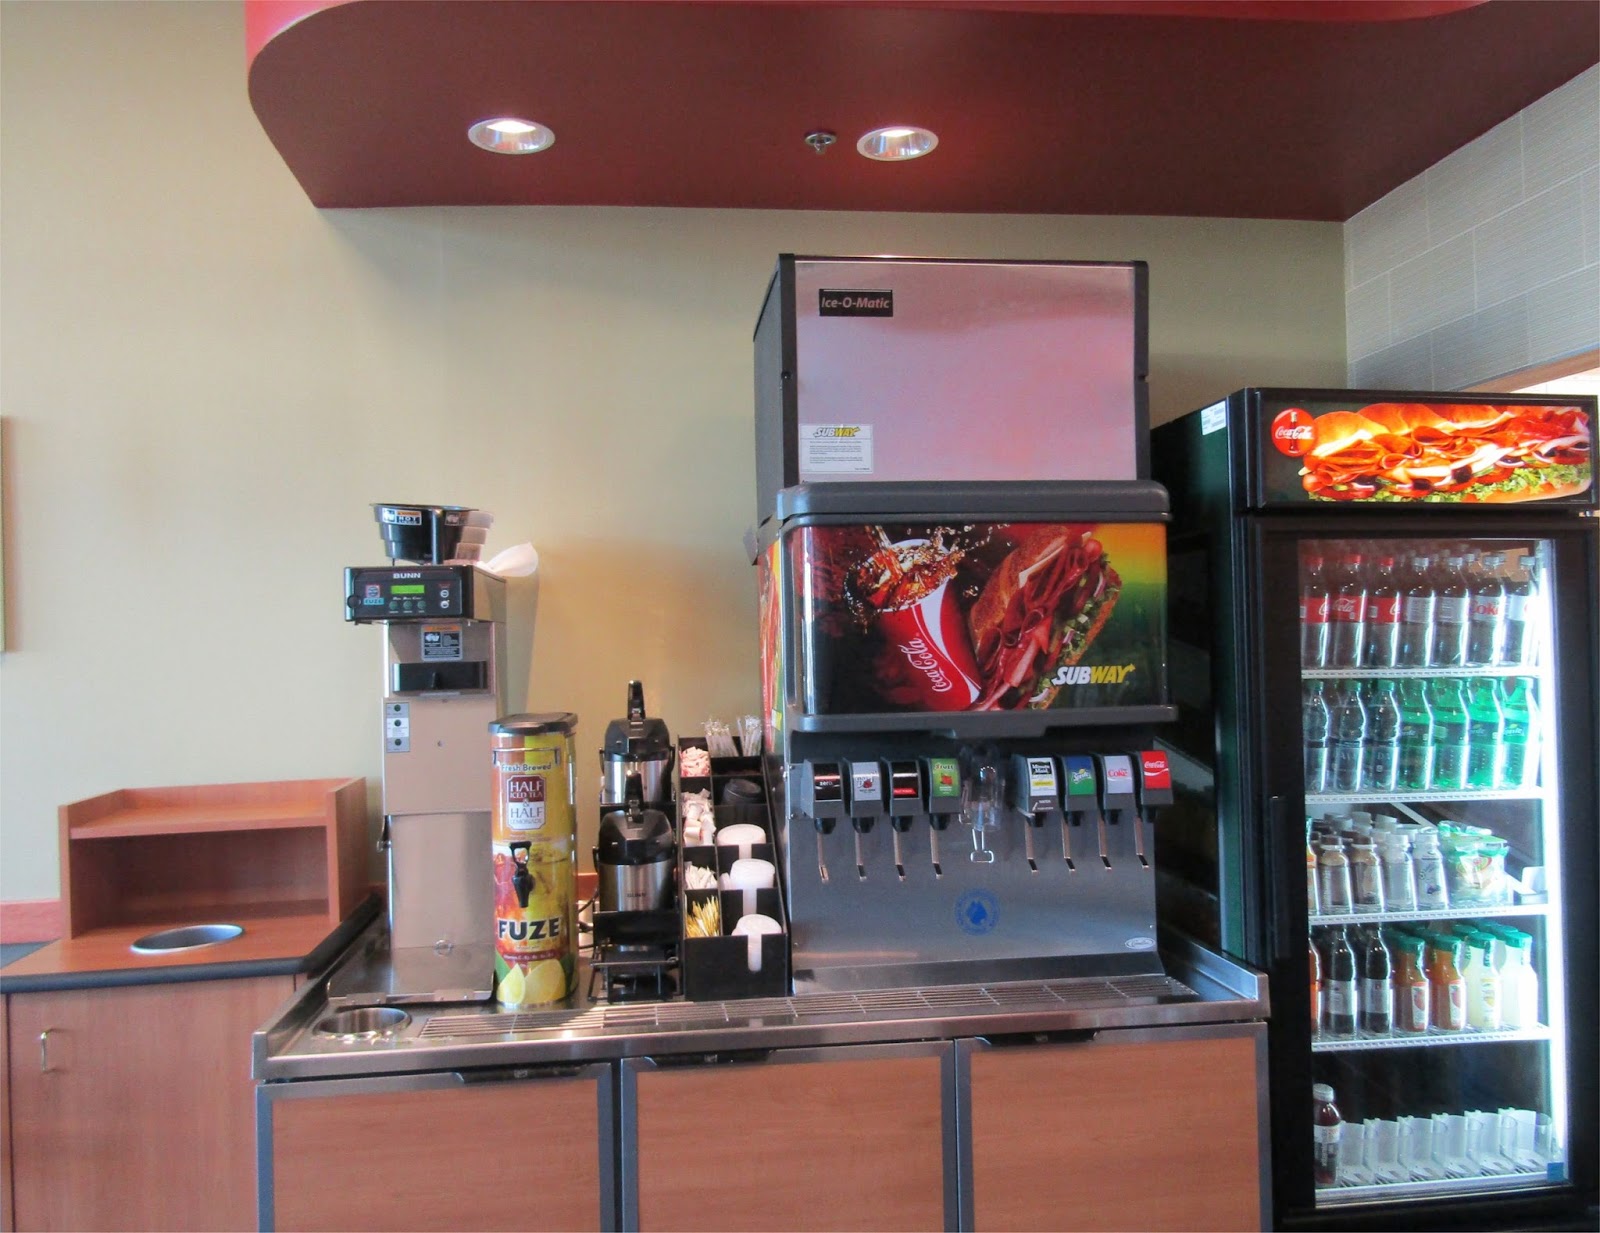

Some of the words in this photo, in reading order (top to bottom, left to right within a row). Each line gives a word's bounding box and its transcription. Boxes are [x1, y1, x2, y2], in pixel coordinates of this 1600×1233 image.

[821, 297, 890, 309] Ice-O-Matic
[813, 426, 861, 438] SUBWAY
[1275, 425, 1314, 440] Coca-Cola
[898, 637, 953, 692] Coca-Cola
[1051, 663, 1136, 686] SUBWAY
[502, 764, 520, 772] Fresh
[523, 763, 552, 771] Brewed
[1107, 769, 1128, 778] Coke
[510, 781, 543, 792] HALF
[510, 807, 543, 819] HALF
[499, 918, 560, 940] FUZE
